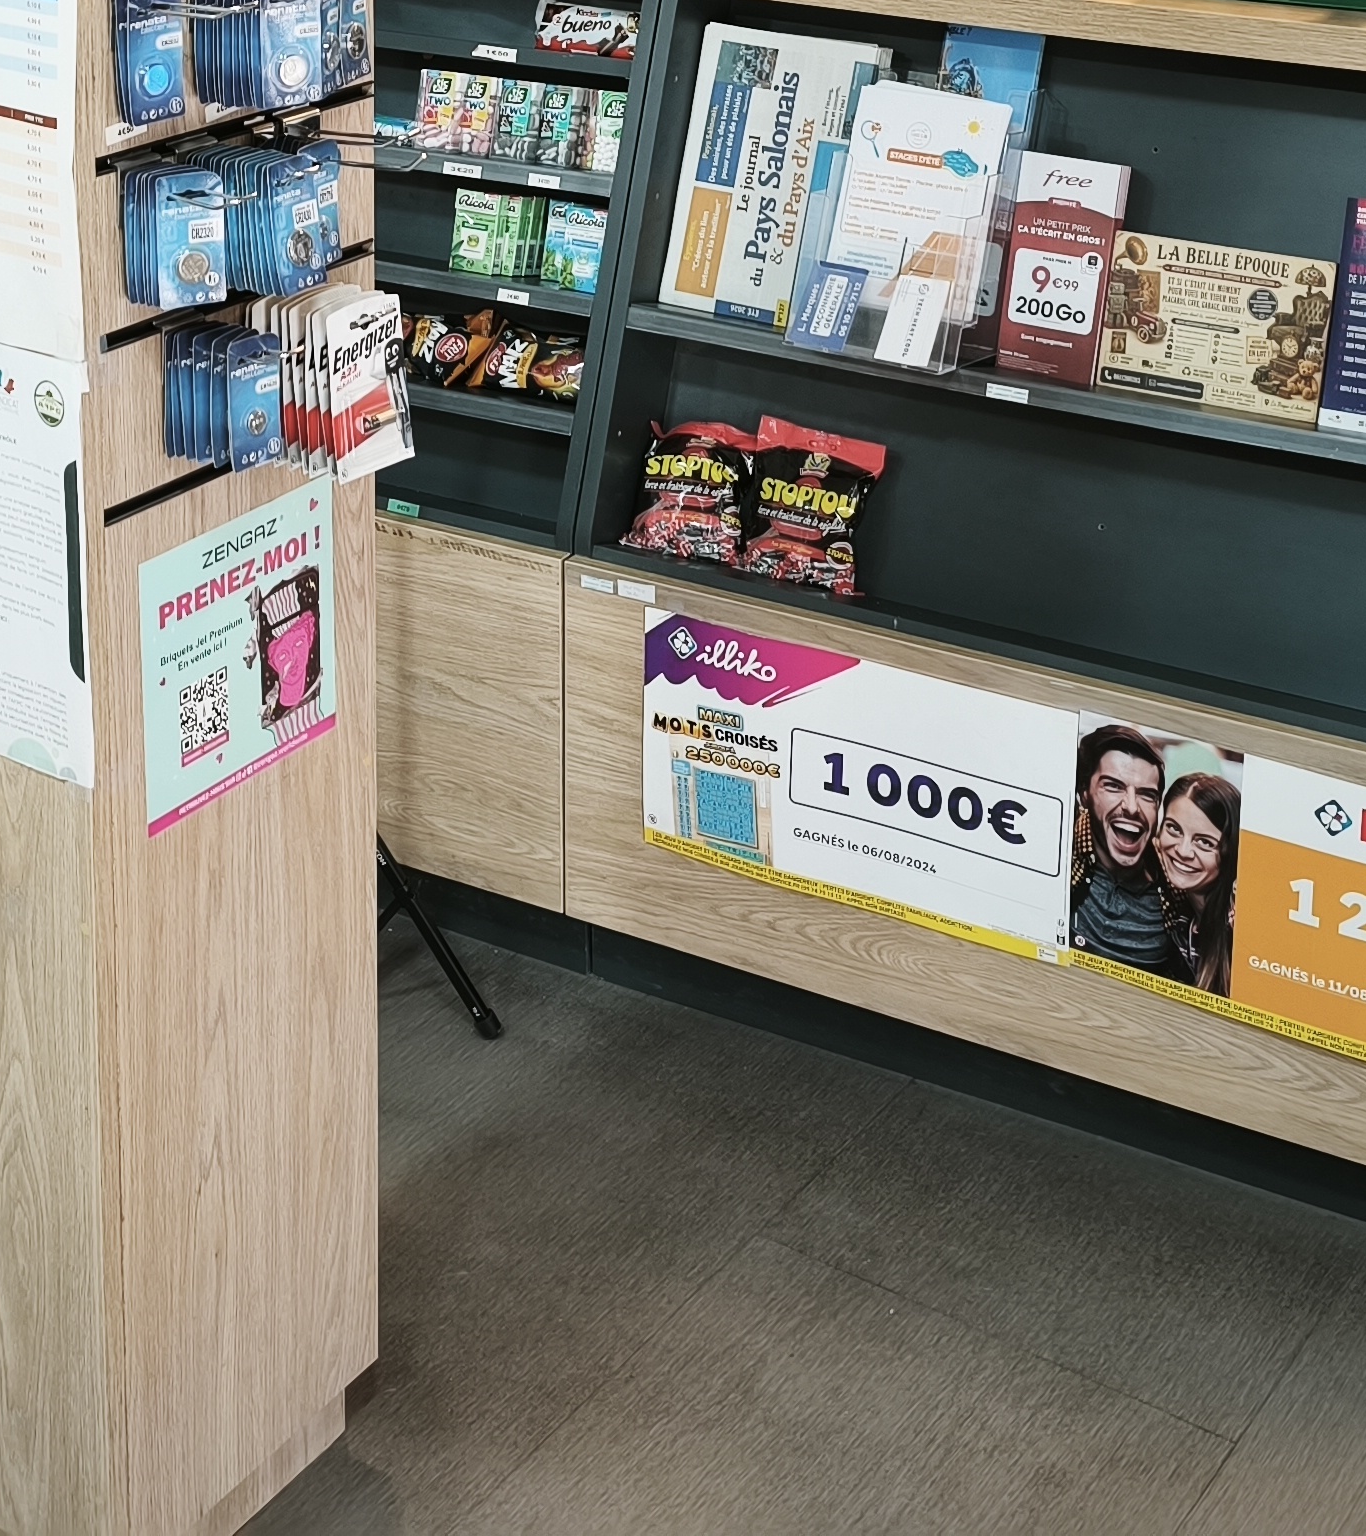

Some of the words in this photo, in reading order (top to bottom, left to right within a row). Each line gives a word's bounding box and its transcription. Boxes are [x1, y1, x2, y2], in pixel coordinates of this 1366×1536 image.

[562, 17, 611, 33] bueno
[758, 72, 800, 190] Salonais
[737, 195, 748, 212] Le
[746, 135, 761, 192] journal
[1043, 170, 1093, 188] free
[459, 194, 495, 211] Ricola
[569, 213, 604, 228] Ricola
[744, 197, 777, 264] Pays
[1033, 217, 1044, 227] UN
[1047, 219, 1070, 230] PETIT
[1071, 224, 1091, 233] PRIX
[750, 267, 762, 287] du
[1157, 244, 1180, 262] LA
[1186, 247, 1230, 268] BELLE
[1235, 252, 1290, 278] ÉPOQUE
[202, 518, 278, 569] ZENGAZ
[158, 532, 307, 630] PRENEZ-MOI
[314, 525, 320, 549] !
[696, 639, 776, 682] illiko
[653, 713, 713, 739] MOTS
[715, 728, 778, 752] CROISÉS
[699, 708, 741, 727] MAXI
[823, 752, 850, 795] 1
[866, 763, 1028, 845] 000€
[793, 827, 845, 851] GAGNÉS
[847, 841, 858, 853] le
[861, 844, 938, 874] 06/08/2024
[1287, 879, 1320, 928] 1
[1248, 956, 1308, 984] GAGNÉS
[1311, 977, 1325, 988] le
